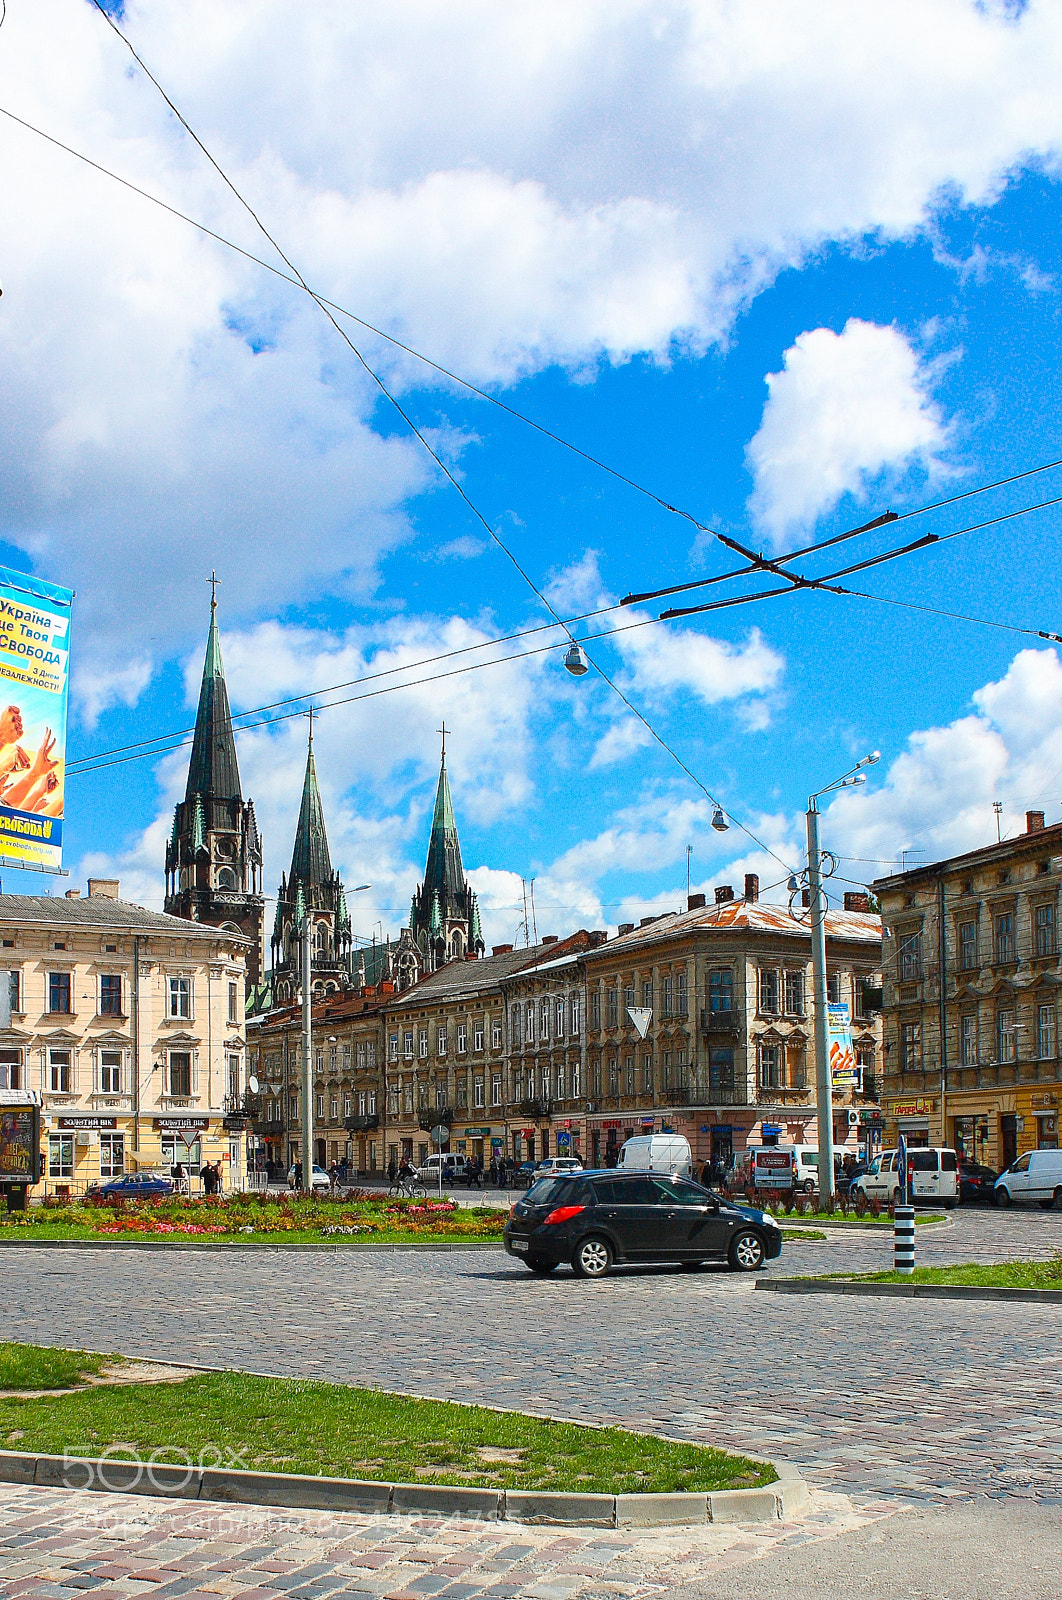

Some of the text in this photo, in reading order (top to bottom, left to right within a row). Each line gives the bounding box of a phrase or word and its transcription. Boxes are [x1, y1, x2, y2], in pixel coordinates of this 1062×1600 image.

[0, 600, 51, 628] Україна
[20, 623, 49, 643] Твоя
[0, 634, 60, 665] СВОБОДА
